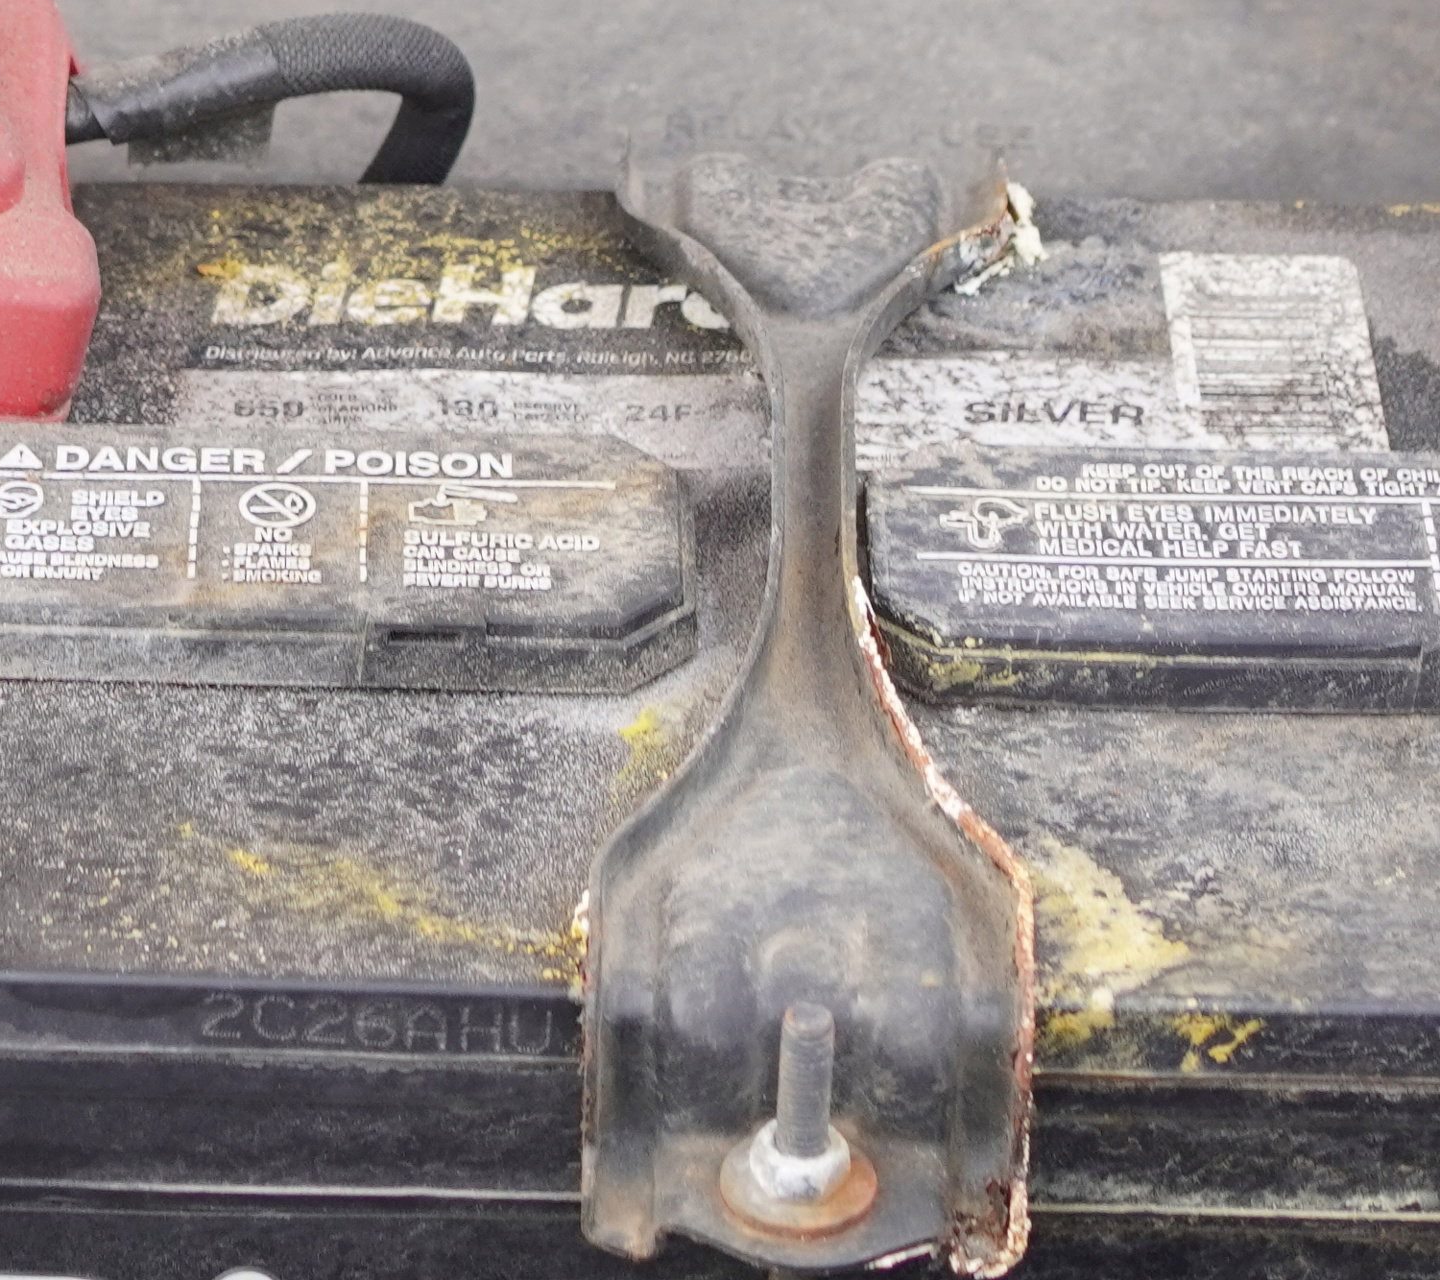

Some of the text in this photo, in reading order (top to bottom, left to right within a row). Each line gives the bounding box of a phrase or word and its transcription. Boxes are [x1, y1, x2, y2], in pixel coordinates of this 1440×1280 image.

[964, 399, 1146, 426] SILVER
[55, 443, 514, 479] DANGER / POISON
[1081, 463, 1137, 479] KEEP
[1142, 463, 1188, 480] OUT
[1194, 464, 1226, 480] OF
[1232, 465, 1275, 481] THE
[1281, 466, 1355, 482] REACH
[1360, 467, 1389, 483] OF
[1035, 476, 1068, 491] DO
[1075, 478, 1119, 493] NOT
[1126, 478, 1167, 493] TIP.
[1176, 479, 1232, 494] KEEP
[1237, 480, 1294, 495] VENT
[1300, 481, 1359, 497] CAPS
[1367, 482, 1428, 497] TIGHT
[70, 489, 166, 507] SHIELD
[70, 506, 139, 522] EYES
[1033, 502, 1378, 525] FLUSH EYES IMMEDIATELY
[5, 518, 152, 539] EXPLOSIVE
[254, 527, 293, 543] NO
[1036, 521, 1271, 541] WITH WATER. GET
[4, 535, 95, 552] GASES
[234, 543, 312, 557] SPARKS
[403, 529, 601, 552] SULFURIC ACID
[1039, 538, 1303, 559] MEDICAL HELP FAST
[50, 552, 159, 569] BLINDNESS
[234, 556, 310, 570] FLAMES
[403, 545, 521, 563] CAN CAUSE
[0, 564, 105, 581] OR INJURY
[233, 569, 322, 584] SMOKING
[403, 558, 552, 578] BLINDNESS OR
[1058, 565, 1100, 581] FOR
[1106, 566, 1158, 582] SAFE
[1164, 567, 1219, 584] JUMP
[1226, 568, 1327, 584] STARTING
[1333, 568, 1416, 585] FOLLOW
[403, 572, 552, 591] SEVERE BURNS
[960, 576, 1109, 596] INSTRUCTIONS
[1114, 580, 1137, 596] IN
[1142, 581, 1226, 597] VEHICLE
[982, 591, 1026, 606] NOT
[1031, 592, 1138, 609] AVAILABLE
[1143, 594, 1197, 610] SEEK
[1203, 595, 1287, 611] SERVICE
[1294, 596, 1424, 613] ASSISTANCE.
